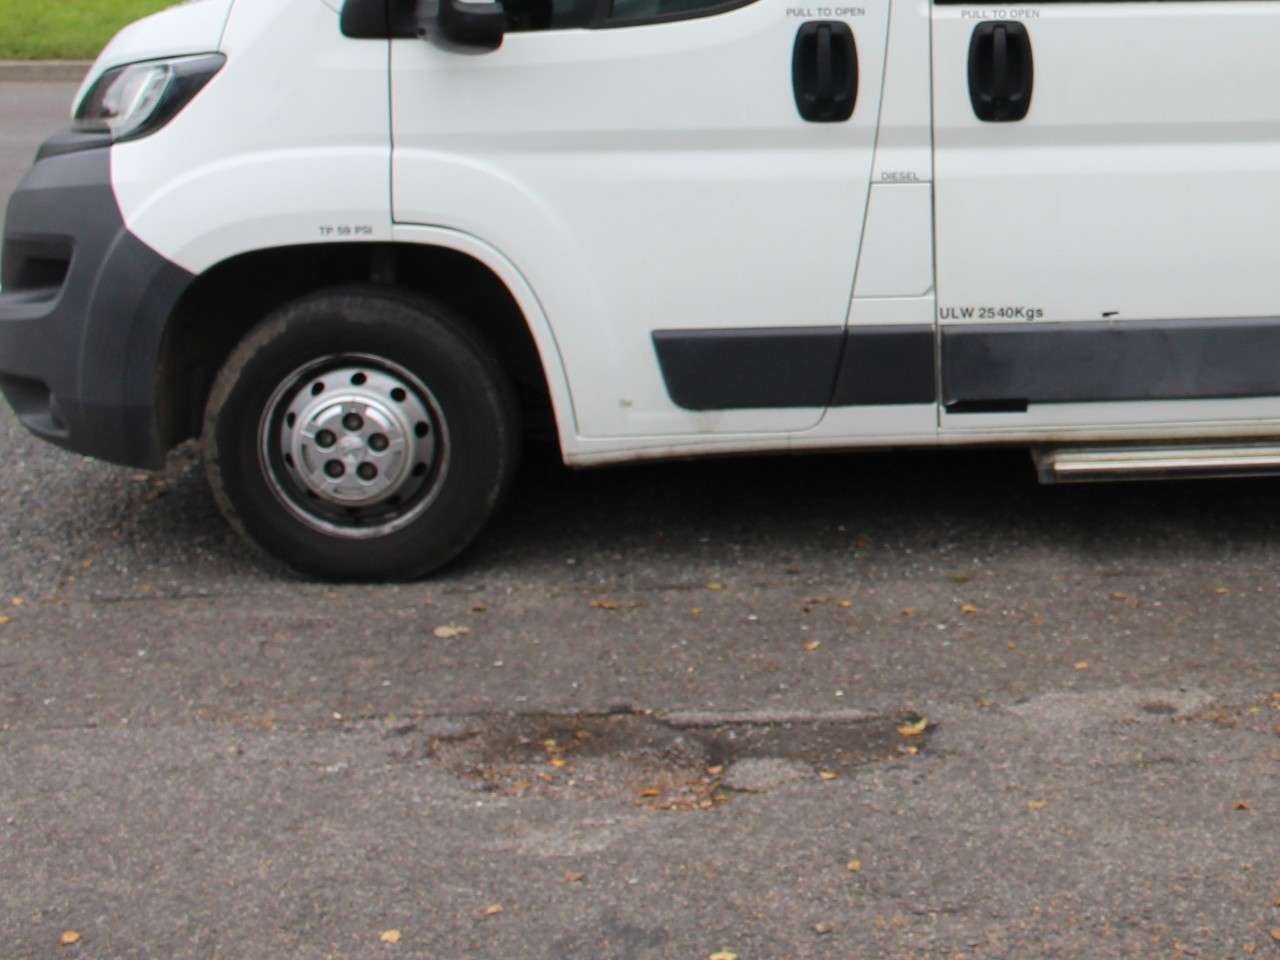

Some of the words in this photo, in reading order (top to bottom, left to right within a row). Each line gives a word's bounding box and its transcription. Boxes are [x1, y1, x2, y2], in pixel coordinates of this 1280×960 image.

[785, 8, 813, 17] PULL
[816, 8, 832, 17] TO
[835, 7, 866, 16] OPEN
[961, 9, 989, 19] PULL
[991, 9, 1008, 19] TO
[1010, 9, 1040, 19] OPEN
[880, 170, 920, 183] DIESEL
[319, 226, 334, 235] TP
[355, 226, 373, 235] PSI
[939, 306, 974, 320] ULW
[978, 305, 1044, 321] 2540Kgs
